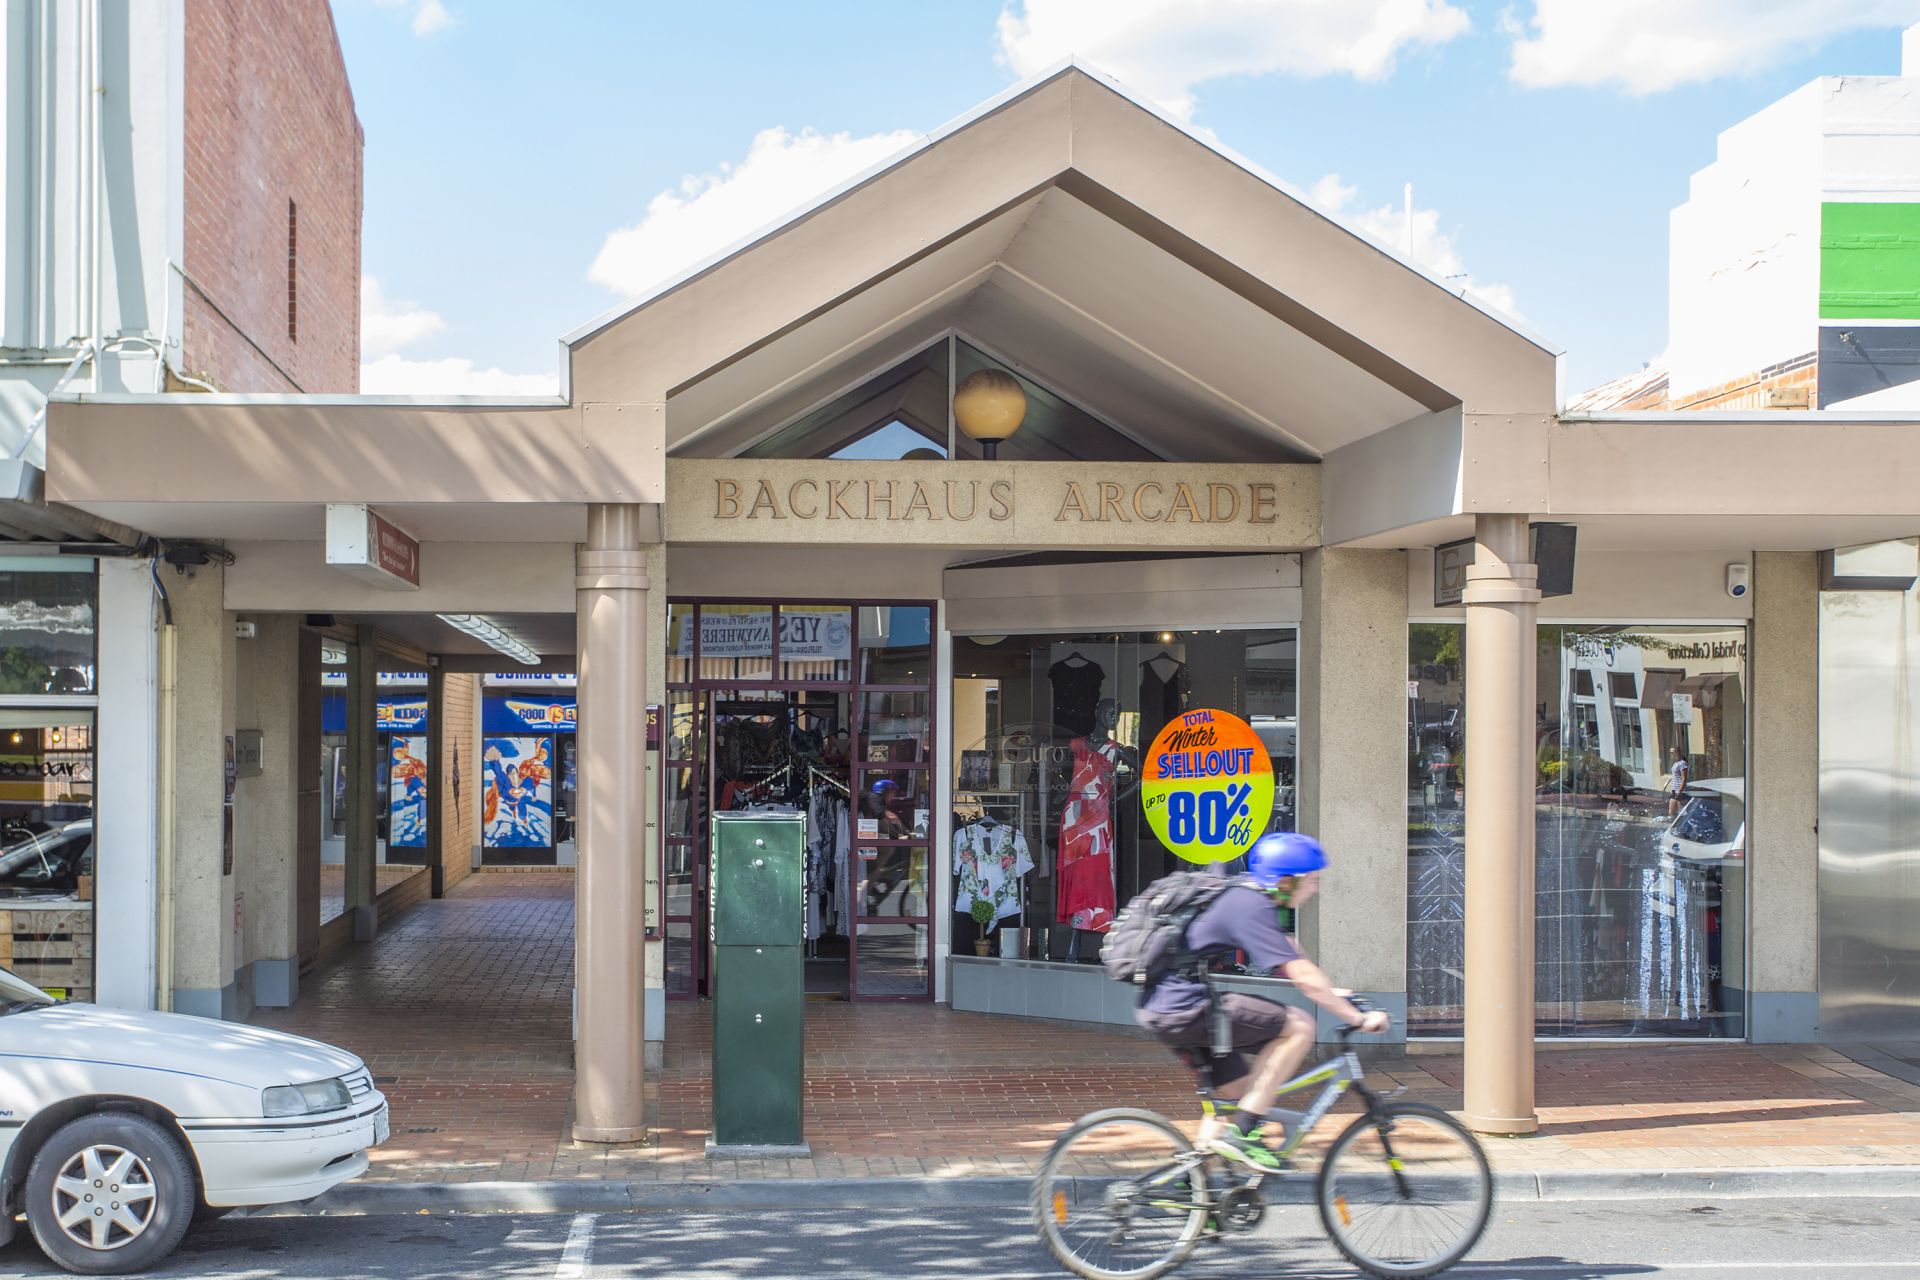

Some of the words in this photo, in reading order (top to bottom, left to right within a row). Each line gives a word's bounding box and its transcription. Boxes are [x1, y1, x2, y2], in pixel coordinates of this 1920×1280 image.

[714, 479, 1015, 521] BACKHAUS
[1054, 481, 1277, 524] ARCADE
[519, 709, 545, 720] GOOD
[1183, 710, 1214, 727] TOTAL
[1163, 726, 1217, 752] Winter
[1158, 748, 1254, 779] SELLOUT
[1168, 782, 1252, 846] 80%
